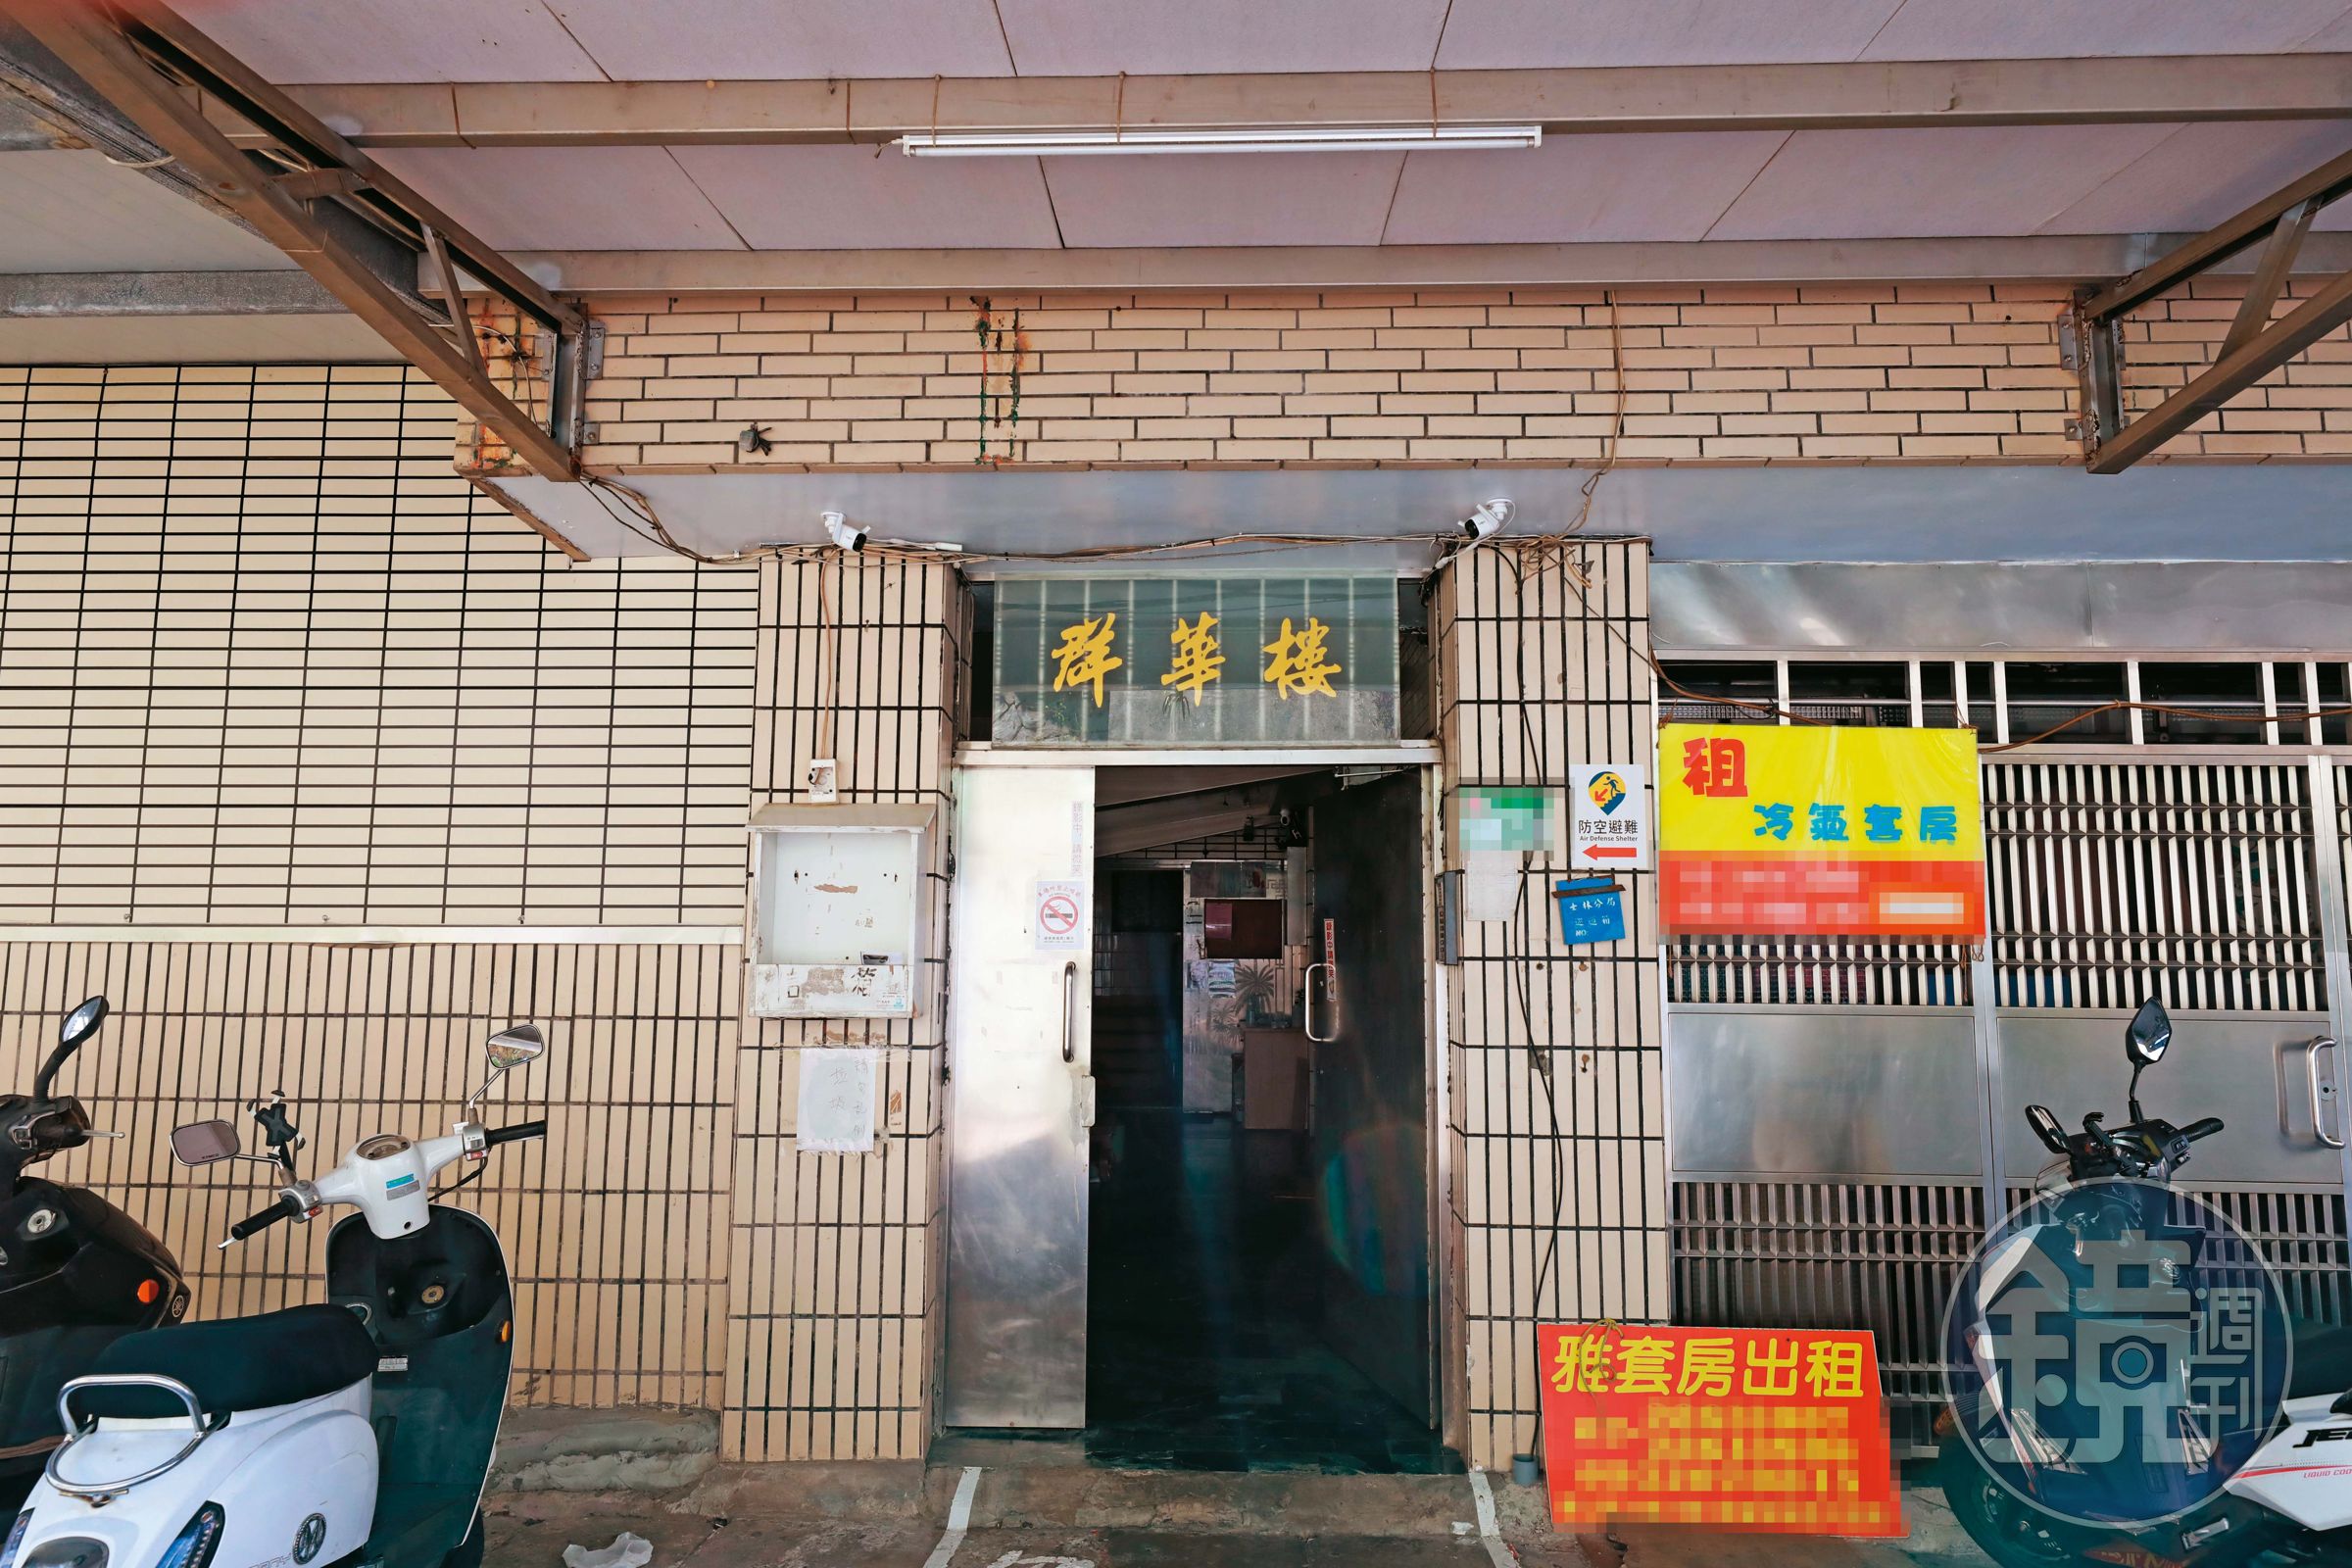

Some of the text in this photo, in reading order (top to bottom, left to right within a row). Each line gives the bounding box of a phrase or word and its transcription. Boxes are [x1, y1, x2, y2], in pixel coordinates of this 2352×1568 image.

[1051, 611, 1341, 709] 群華樓
[1683, 737, 1748, 798] 租
[1578, 819, 1639, 835] 防空避難
[1753, 802, 1958, 846] 冷氣套房
[1569, 897, 1616, 911] 士林分局
[1551, 1334, 1864, 1397] 雅套房出租
